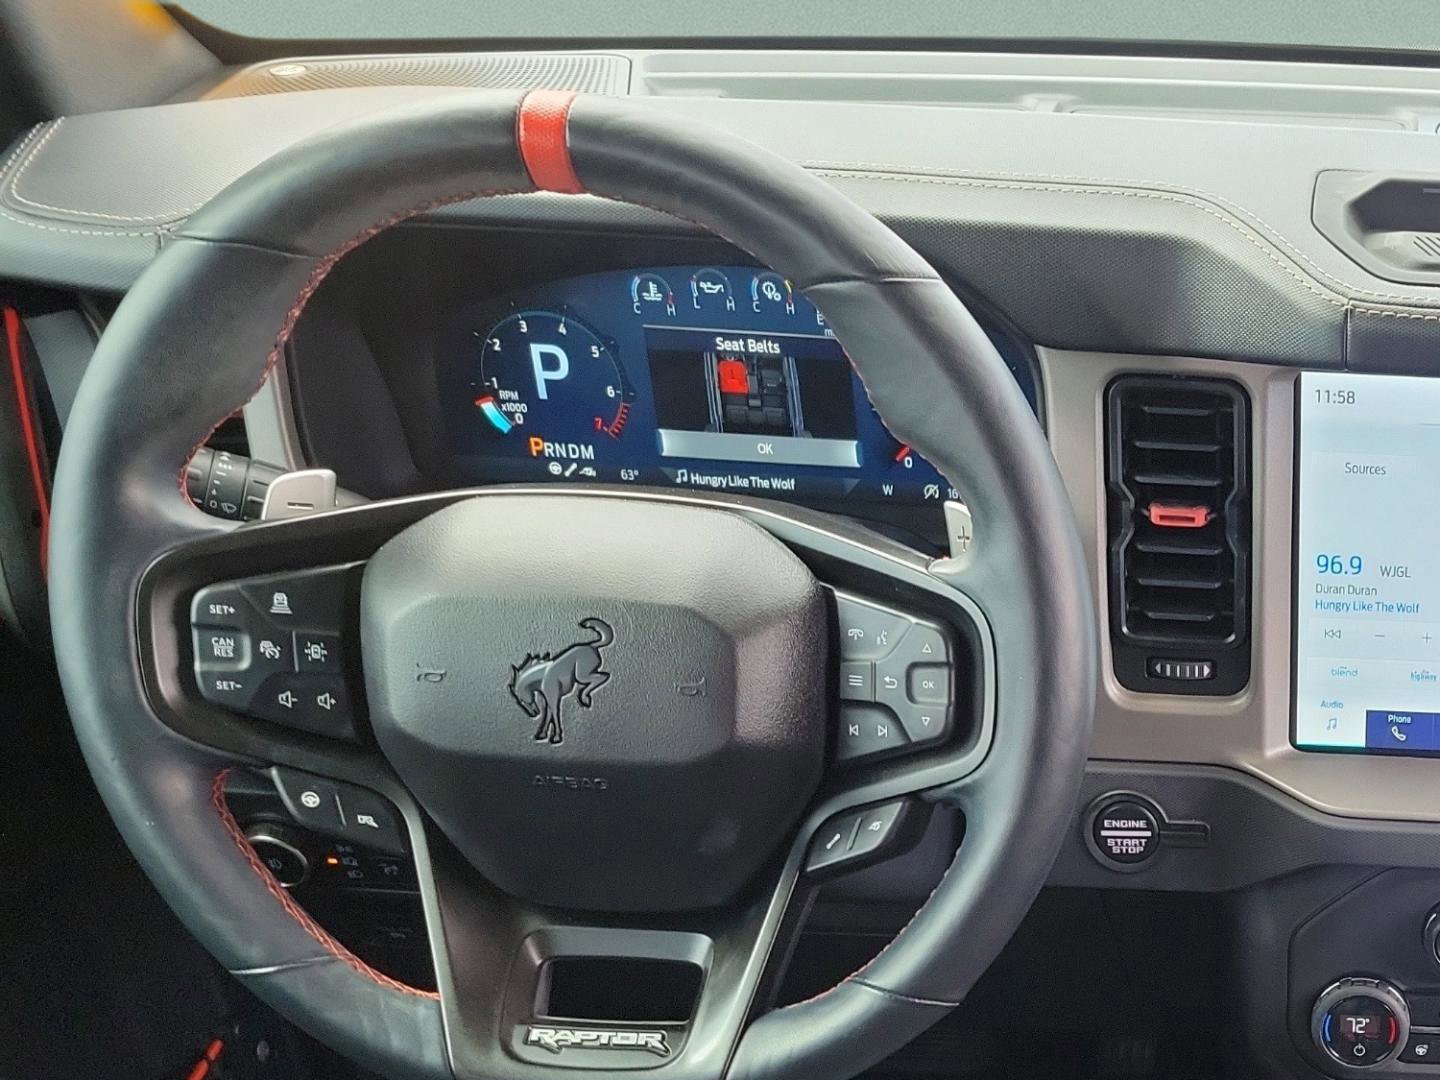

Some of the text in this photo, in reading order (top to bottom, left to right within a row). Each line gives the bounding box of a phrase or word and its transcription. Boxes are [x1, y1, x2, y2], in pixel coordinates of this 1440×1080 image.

[633, 302, 642, 314] C
[667, 303, 677, 317] H
[726, 298, 735, 311] H
[753, 301, 761, 312] C
[786, 303, 795, 315] H
[519, 320, 528, 333] 3
[558, 323, 567, 336] 4
[492, 338, 501, 351] 2
[715, 336, 781, 355] Seat Belts
[591, 345, 600, 358] 5
[529, 342, 569, 400] P
[499, 390, 519, 401] RPM
[606, 385, 616, 398] 6
[1315, 388, 1356, 405] 11:58
[501, 403, 528, 413] x1000
[515, 413, 524, 425] 0
[757, 443, 774, 455] OK
[904, 456, 913, 469] 0
[1344, 462, 1387, 476] Sources
[690, 472, 796, 491] Hungry Like The Wolf
[882, 484, 894, 496] W
[1316, 553, 1362, 576] 96.9
[1380, 565, 1411, 579] WJGL
[1315, 583, 1378, 597] Duran Duran
[209, 604, 236, 616] SET+
[1315, 599, 1420, 614] Hungry Like The Wolf
[211, 636, 235, 648] CAN
[214, 648, 234, 658] RES
[922, 680, 935, 690] OK
[1320, 700, 1344, 710] Audio
[1388, 714, 1412, 724] Phone
[1104, 819, 1148, 829] ENGINE
[1107, 838, 1148, 847] START
[1112, 846, 1144, 854] STOP
[525, 1027, 672, 1058] RAPTOR
